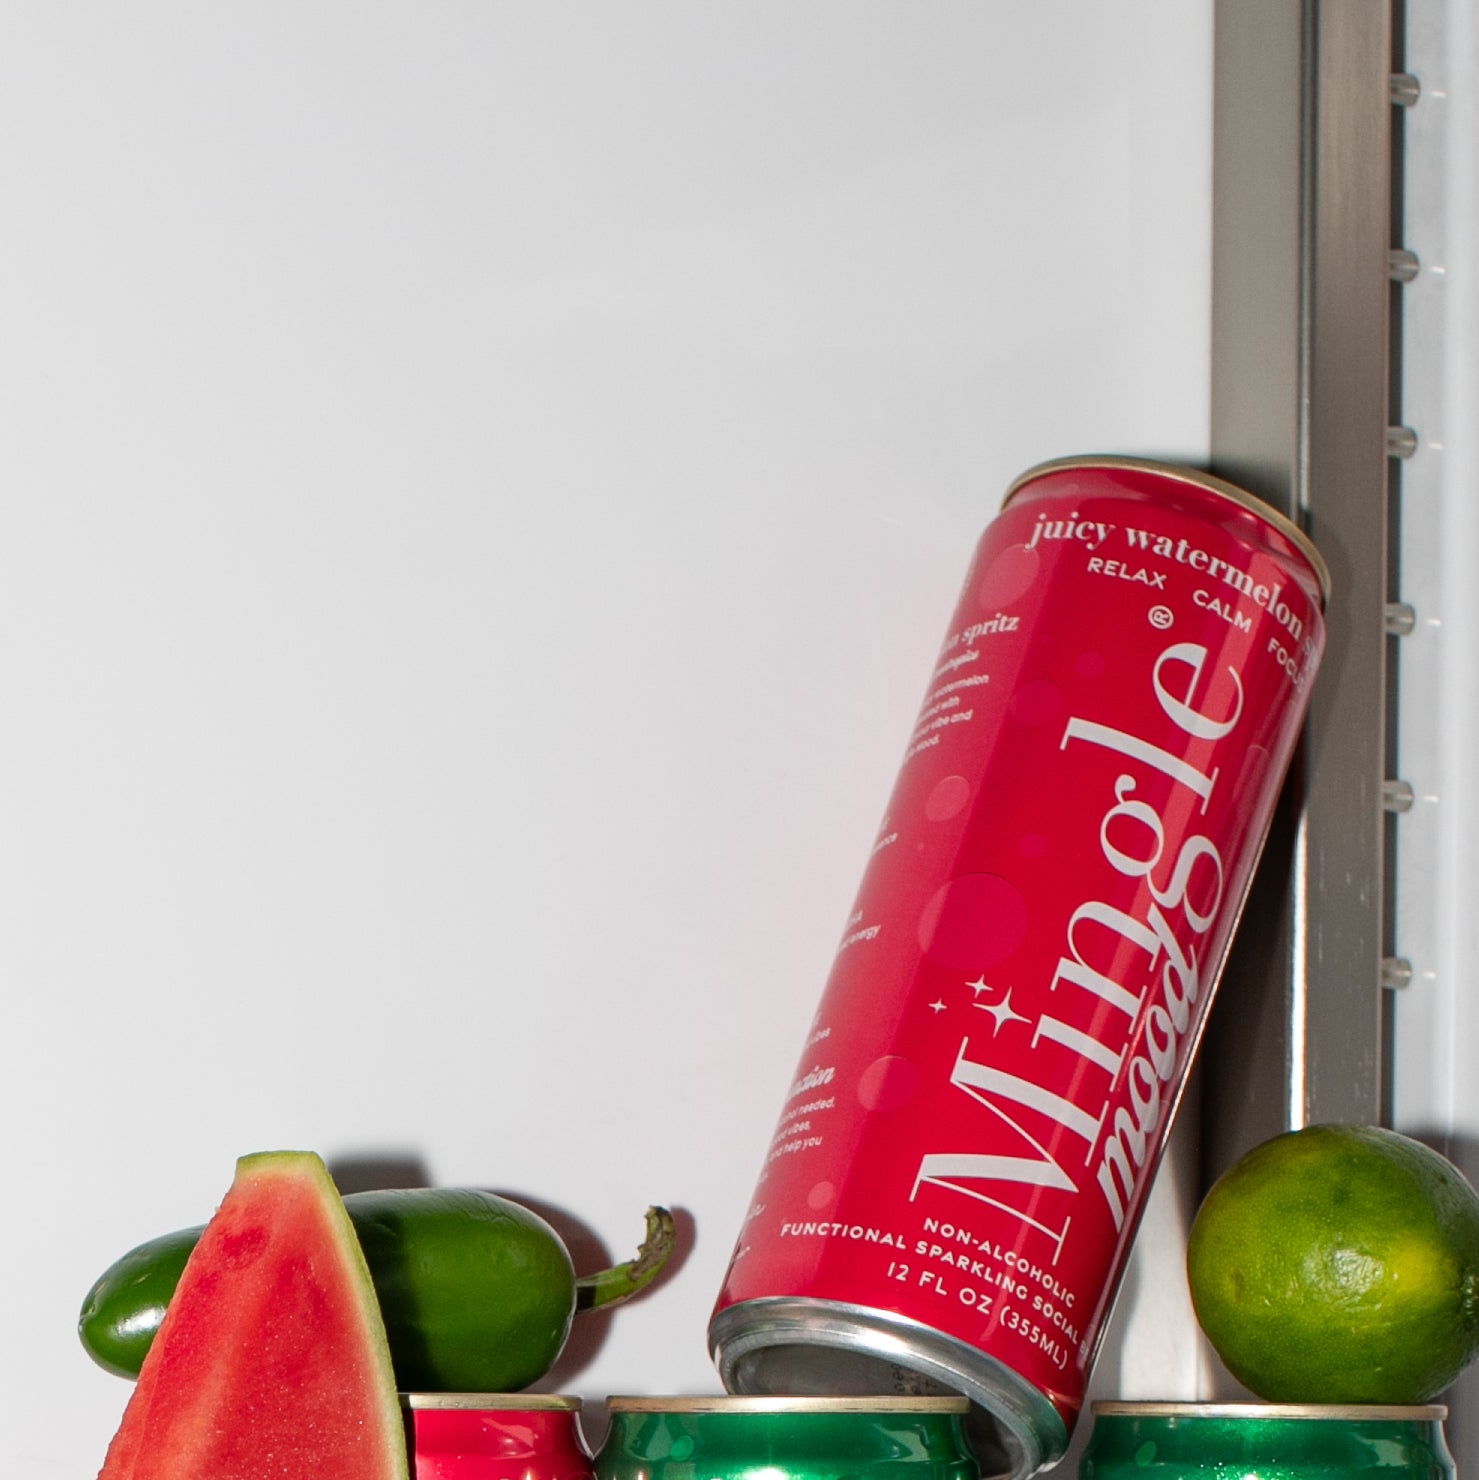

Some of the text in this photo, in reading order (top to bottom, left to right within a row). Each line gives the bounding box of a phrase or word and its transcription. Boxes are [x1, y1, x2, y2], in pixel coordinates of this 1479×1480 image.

[961, 612, 1020, 645] spritz
[1025, 511, 1305, 642] juicy watermelon
[1087, 556, 1168, 591] RELAX
[1192, 588, 1254, 634] CALM
[1096, 901, 1200, 1235] mood
[780, 1222, 1079, 1346] FUNCTIONAL SPARKLING SOCIAL
[887, 1261, 1070, 1371] 12 FL OZ (355ML)
[924, 1217, 1076, 1309] NON-ALCOHOLIC
